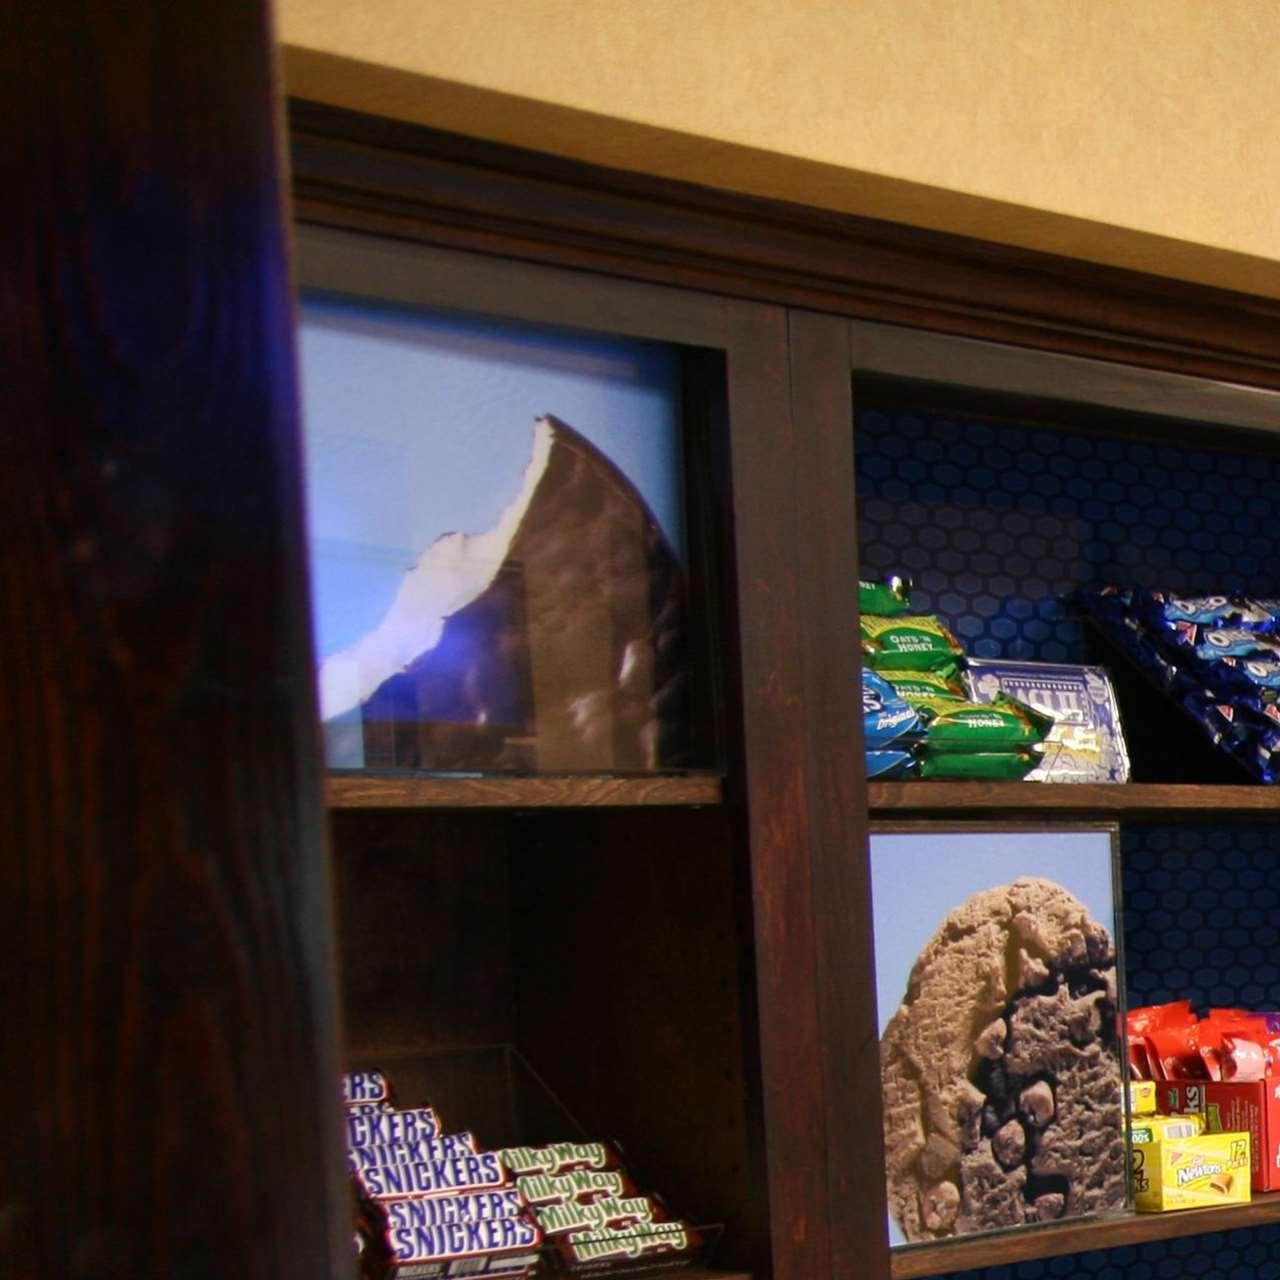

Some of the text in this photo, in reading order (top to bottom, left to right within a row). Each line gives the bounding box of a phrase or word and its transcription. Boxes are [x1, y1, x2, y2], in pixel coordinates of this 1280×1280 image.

[897, 643, 933, 652] HONEY
[877, 709, 914, 730] Original
[1131, 1133, 1149, 1144] 00%
[364, 1154, 502, 1195] SNICKERS
[389, 1191, 520, 1229] SNICKERS
[395, 1219, 536, 1260] SNICKERS
